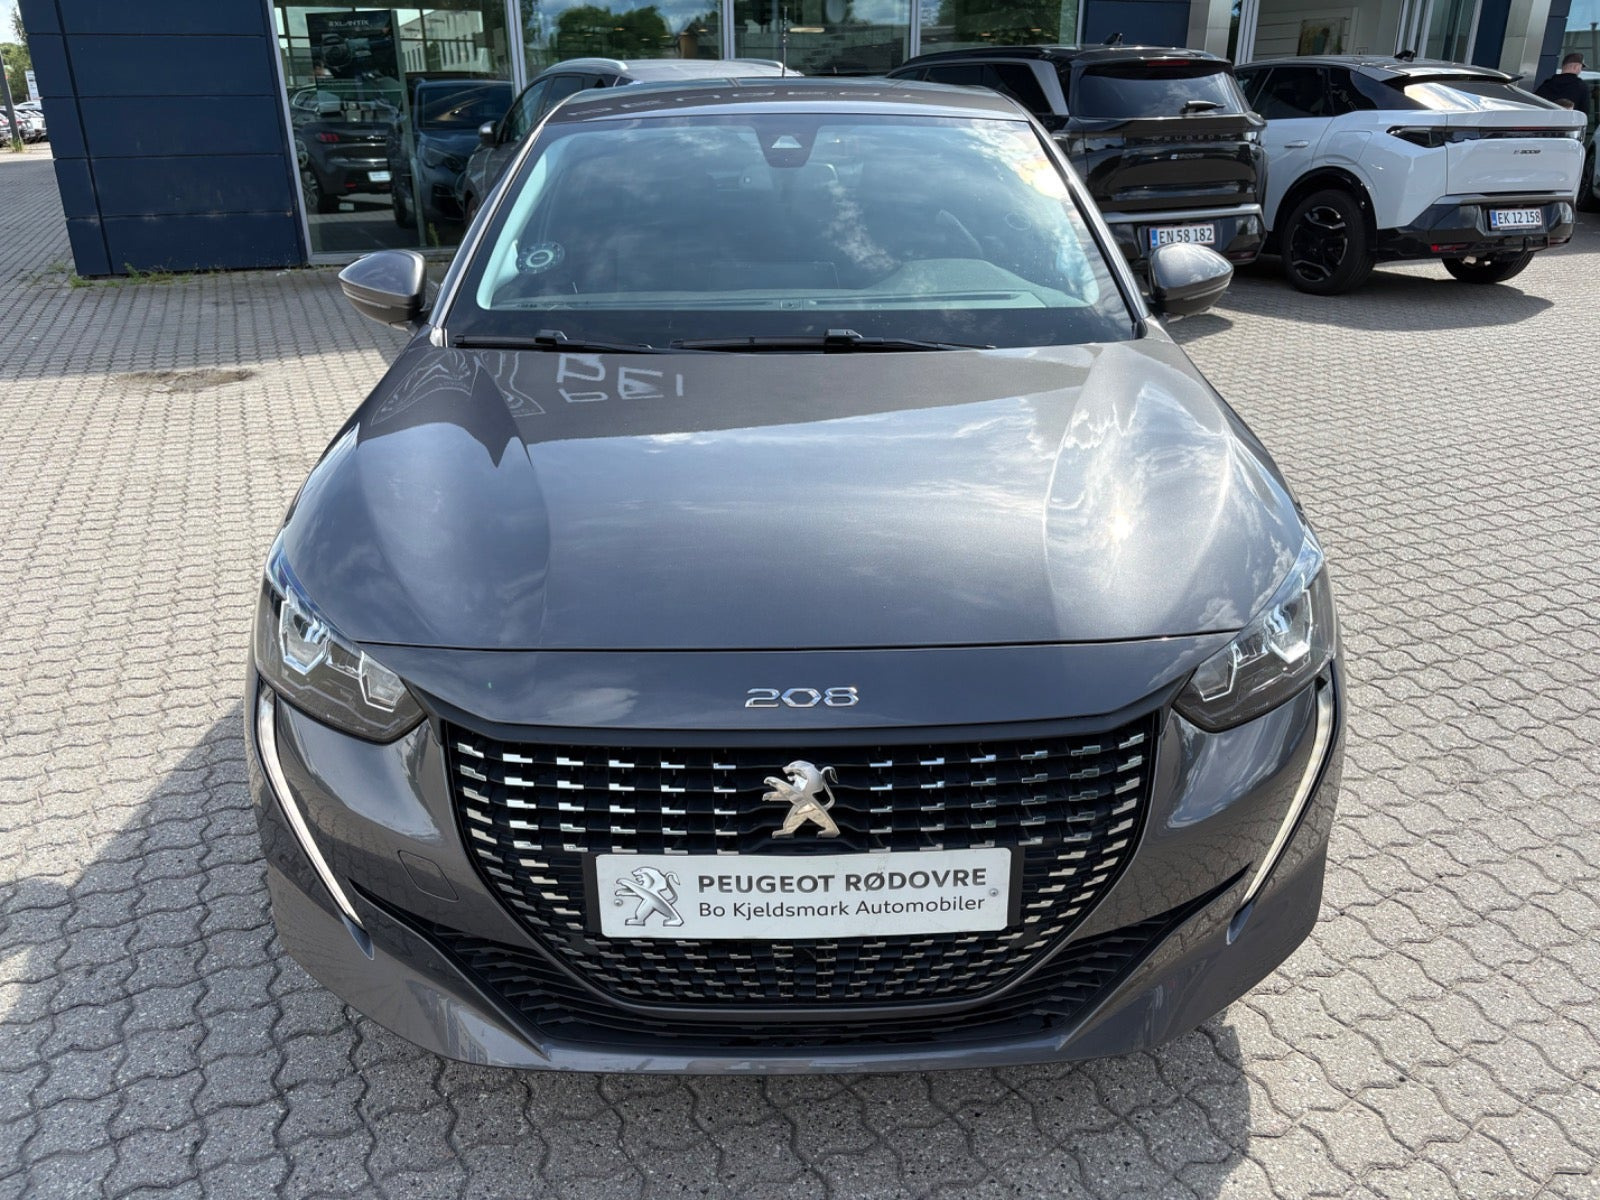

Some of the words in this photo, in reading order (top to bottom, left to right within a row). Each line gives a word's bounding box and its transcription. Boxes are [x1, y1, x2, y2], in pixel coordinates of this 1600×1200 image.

[1497, 212, 1510, 224] EK
[1512, 211, 1524, 224] 12
[1525, 210, 1541, 224] 158
[1159, 230, 1174, 244] EN
[1176, 229, 1191, 243] 58
[1193, 227, 1213, 242] 182
[745, 686, 860, 708] 208
[698, 874, 835, 894] PEUGEOT
[845, 868, 987, 893] RØDOVRE
[699, 902, 726, 917] Bo
[733, 900, 850, 920] Kjeldsmark
[855, 896, 986, 916] Automobiler
